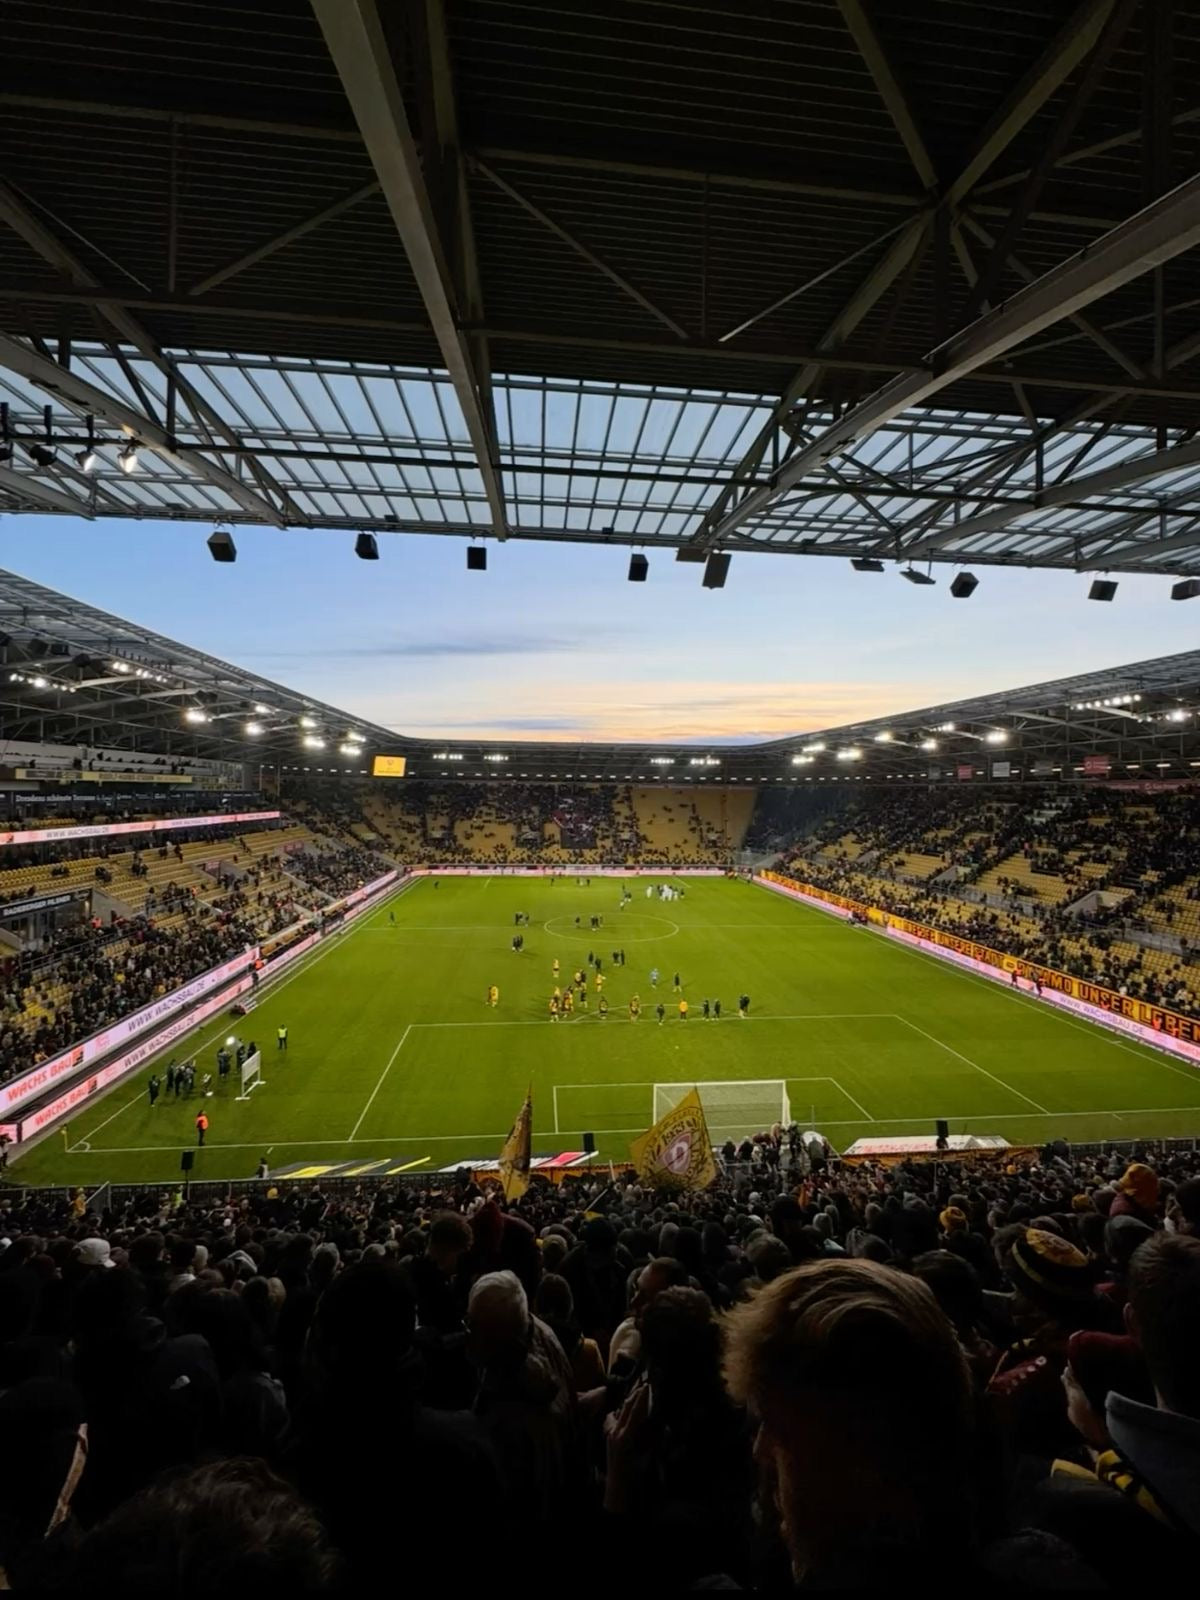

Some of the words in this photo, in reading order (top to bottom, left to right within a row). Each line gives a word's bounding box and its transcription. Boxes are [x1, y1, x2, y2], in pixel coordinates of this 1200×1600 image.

[1080, 982, 1133, 1017] UNSER
[7, 1070, 48, 1102] WACHS
[50, 1055, 73, 1078] BAU
